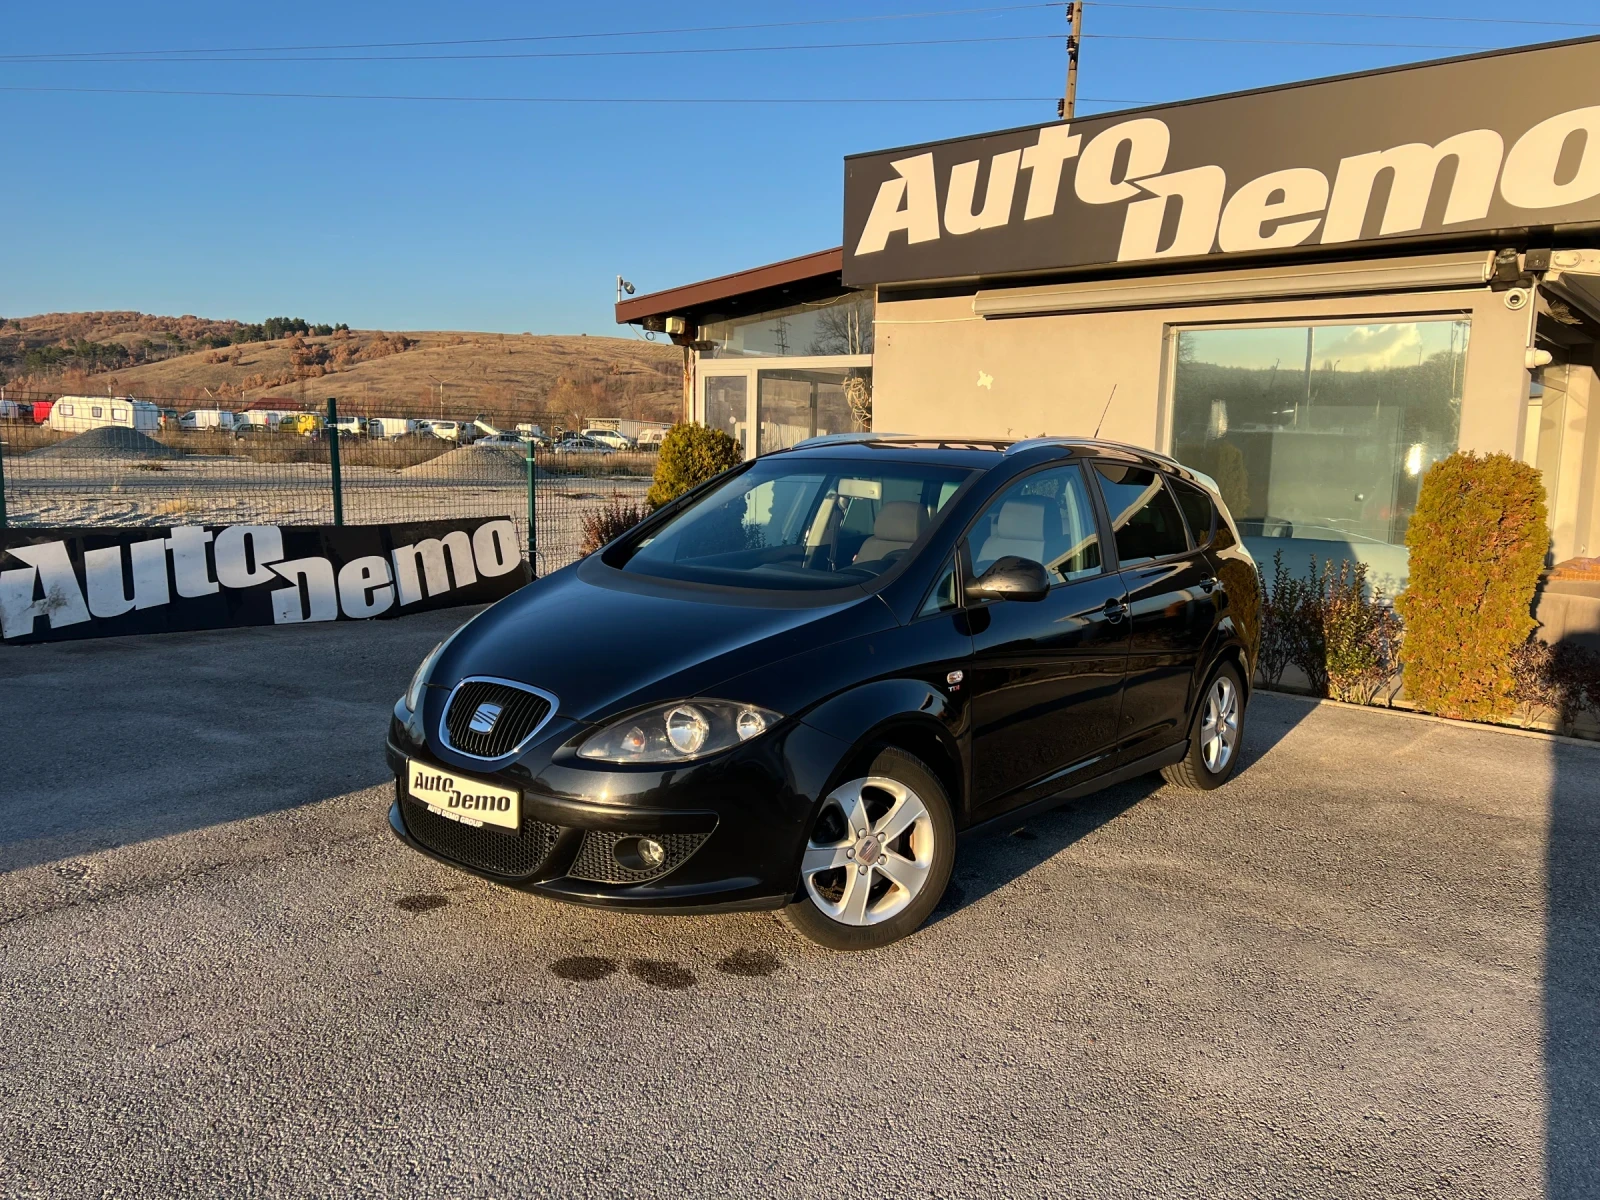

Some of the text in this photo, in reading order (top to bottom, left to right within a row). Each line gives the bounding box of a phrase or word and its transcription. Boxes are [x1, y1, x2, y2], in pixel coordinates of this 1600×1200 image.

[854, 118, 1171, 256] Auto
[1116, 105, 1600, 263] Demo
[0, 525, 285, 639] Auto
[271, 520, 522, 625] Demo
[414, 772, 454, 792] Auto
[428, 804, 483, 828] AUTO DEMO GROUP
[448, 790, 511, 811] Demo
